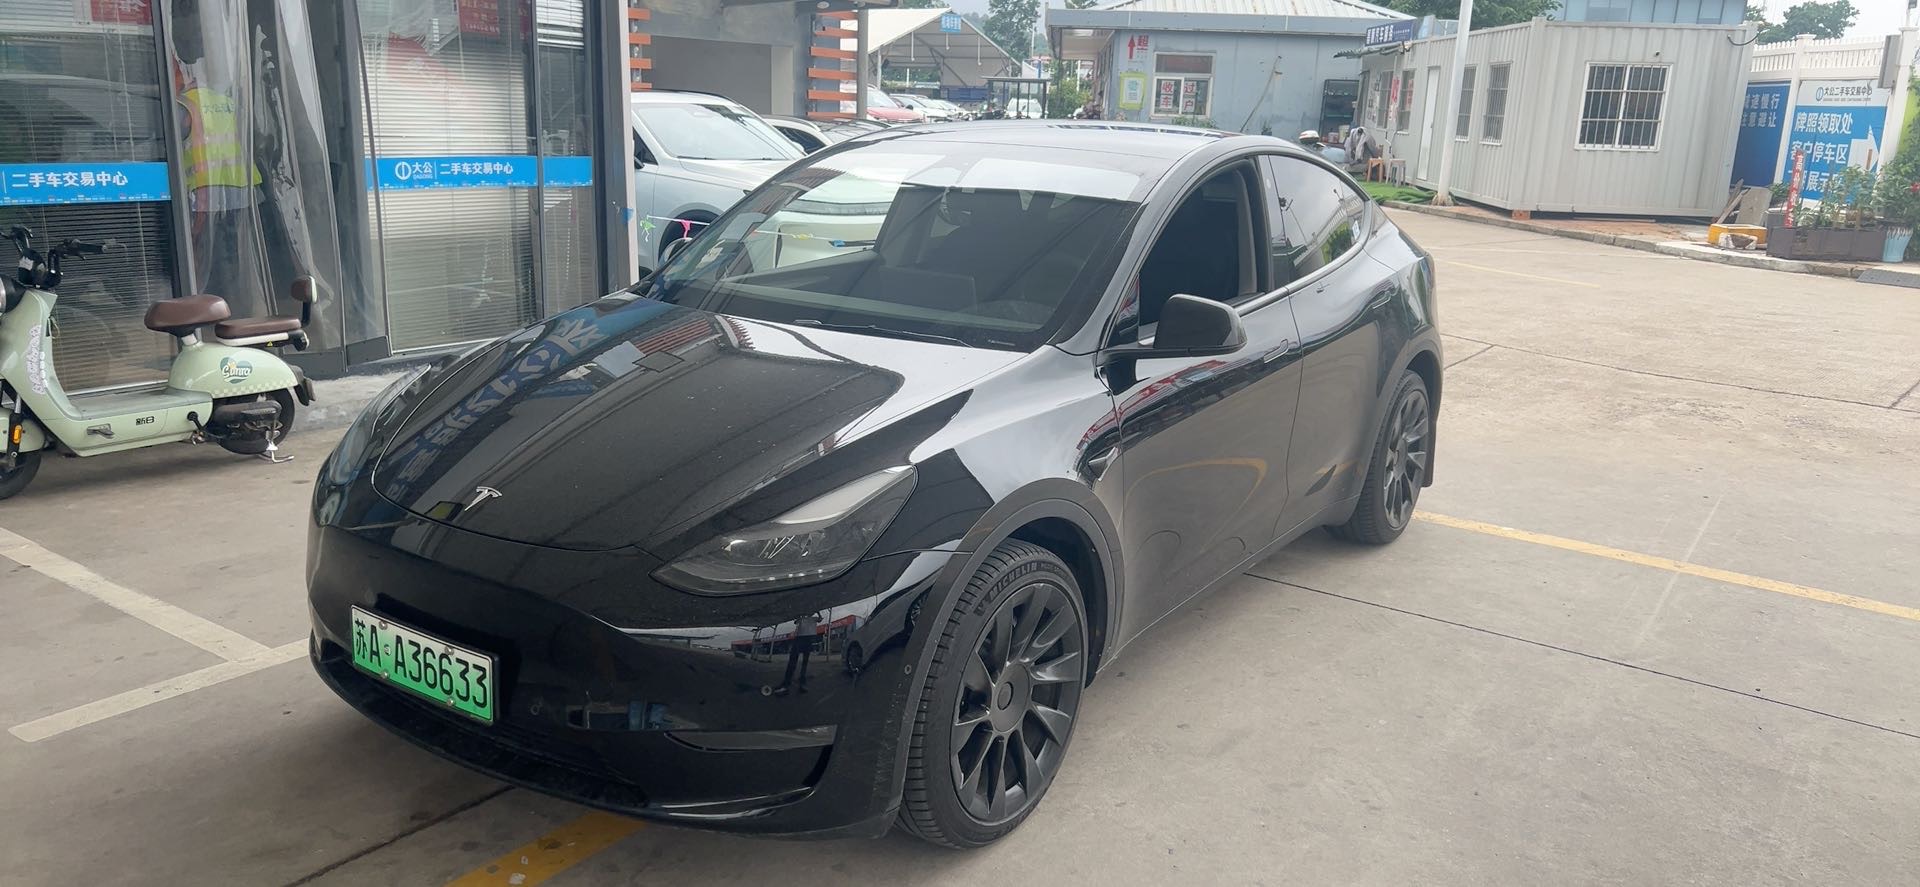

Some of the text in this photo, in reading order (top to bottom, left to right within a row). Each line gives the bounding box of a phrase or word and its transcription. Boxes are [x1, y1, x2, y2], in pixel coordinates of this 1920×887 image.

[1823, 86, 1872, 96] 大公二手车交易中心
[1794, 112, 1853, 135] 牌照领取处
[1790, 141, 1849, 164] 客户停车区
[412, 162, 514, 175] 大公 二手车交易中心
[12, 171, 128, 188] 二手车交易中心
[988, 562, 1038, 602] MICHELIN
